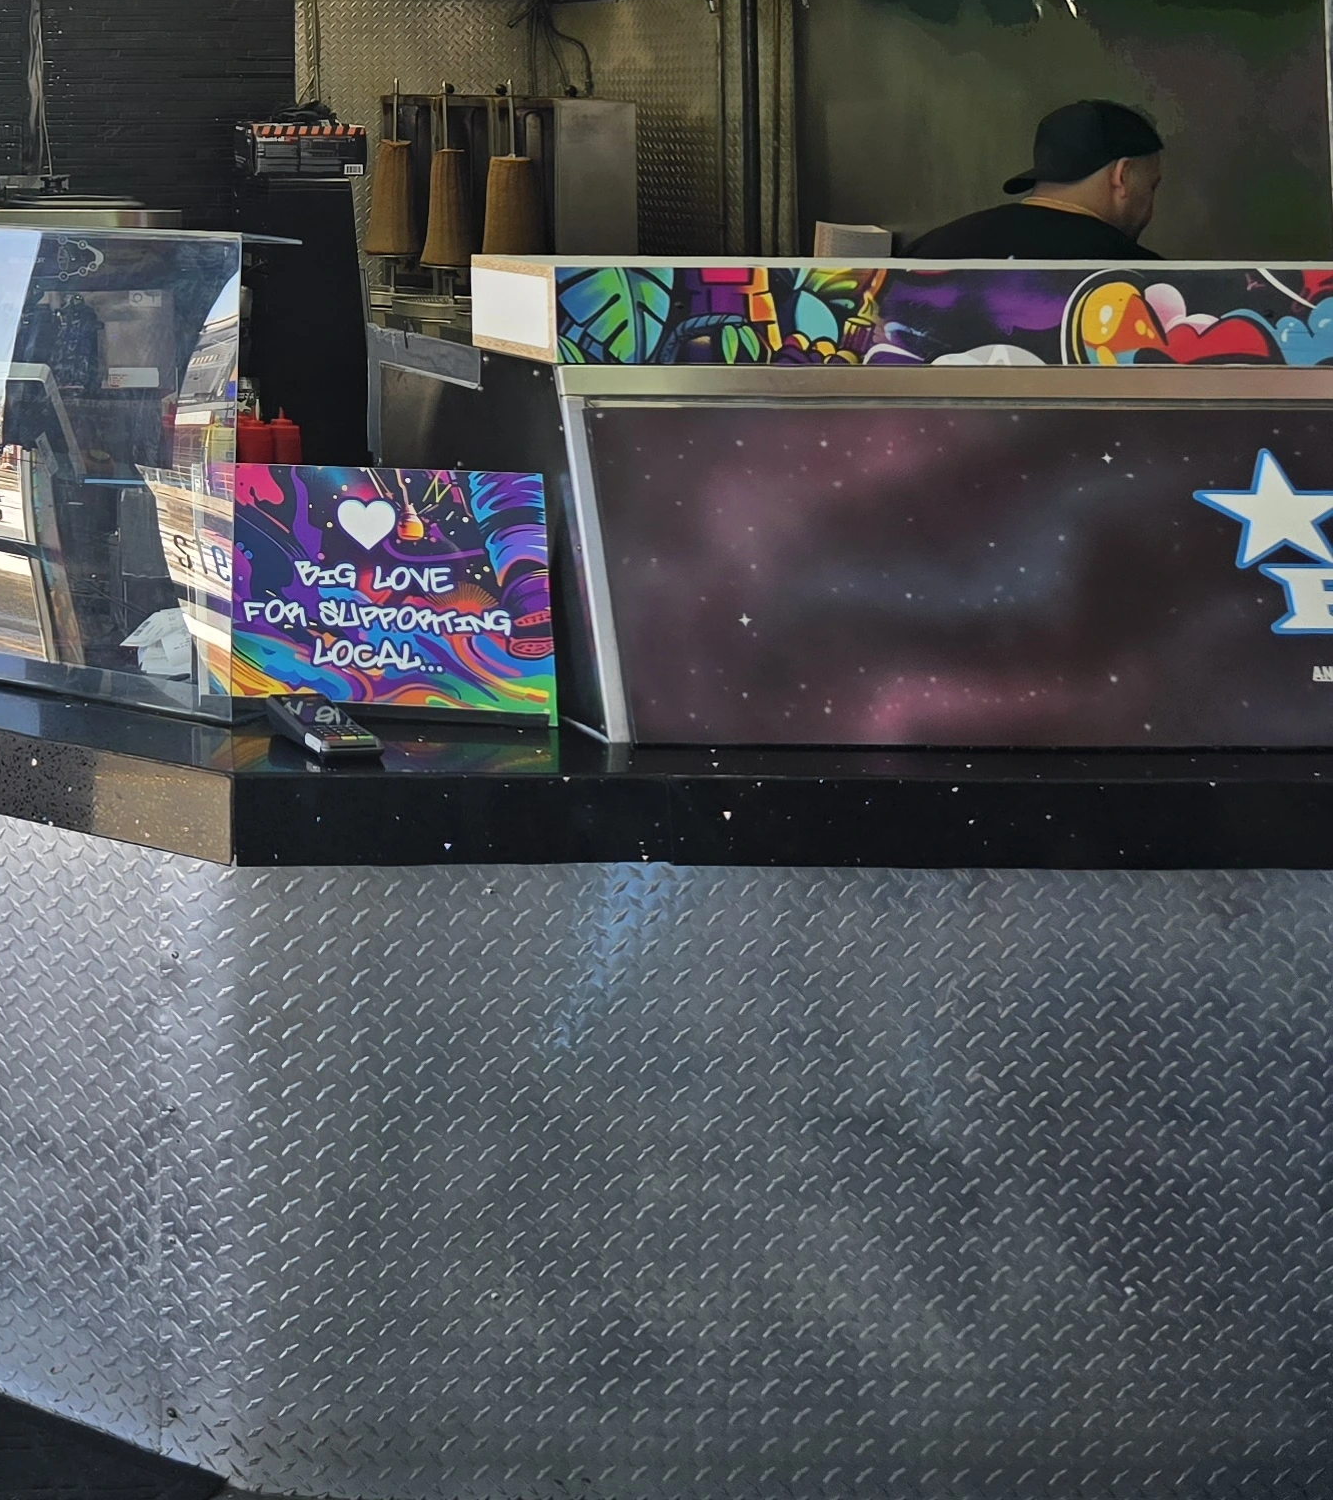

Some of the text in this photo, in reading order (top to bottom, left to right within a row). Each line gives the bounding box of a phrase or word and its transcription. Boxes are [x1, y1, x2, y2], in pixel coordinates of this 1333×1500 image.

[294, 560, 454, 592] BIG LOVE
[243, 600, 512, 637] FOR SUPPORTING
